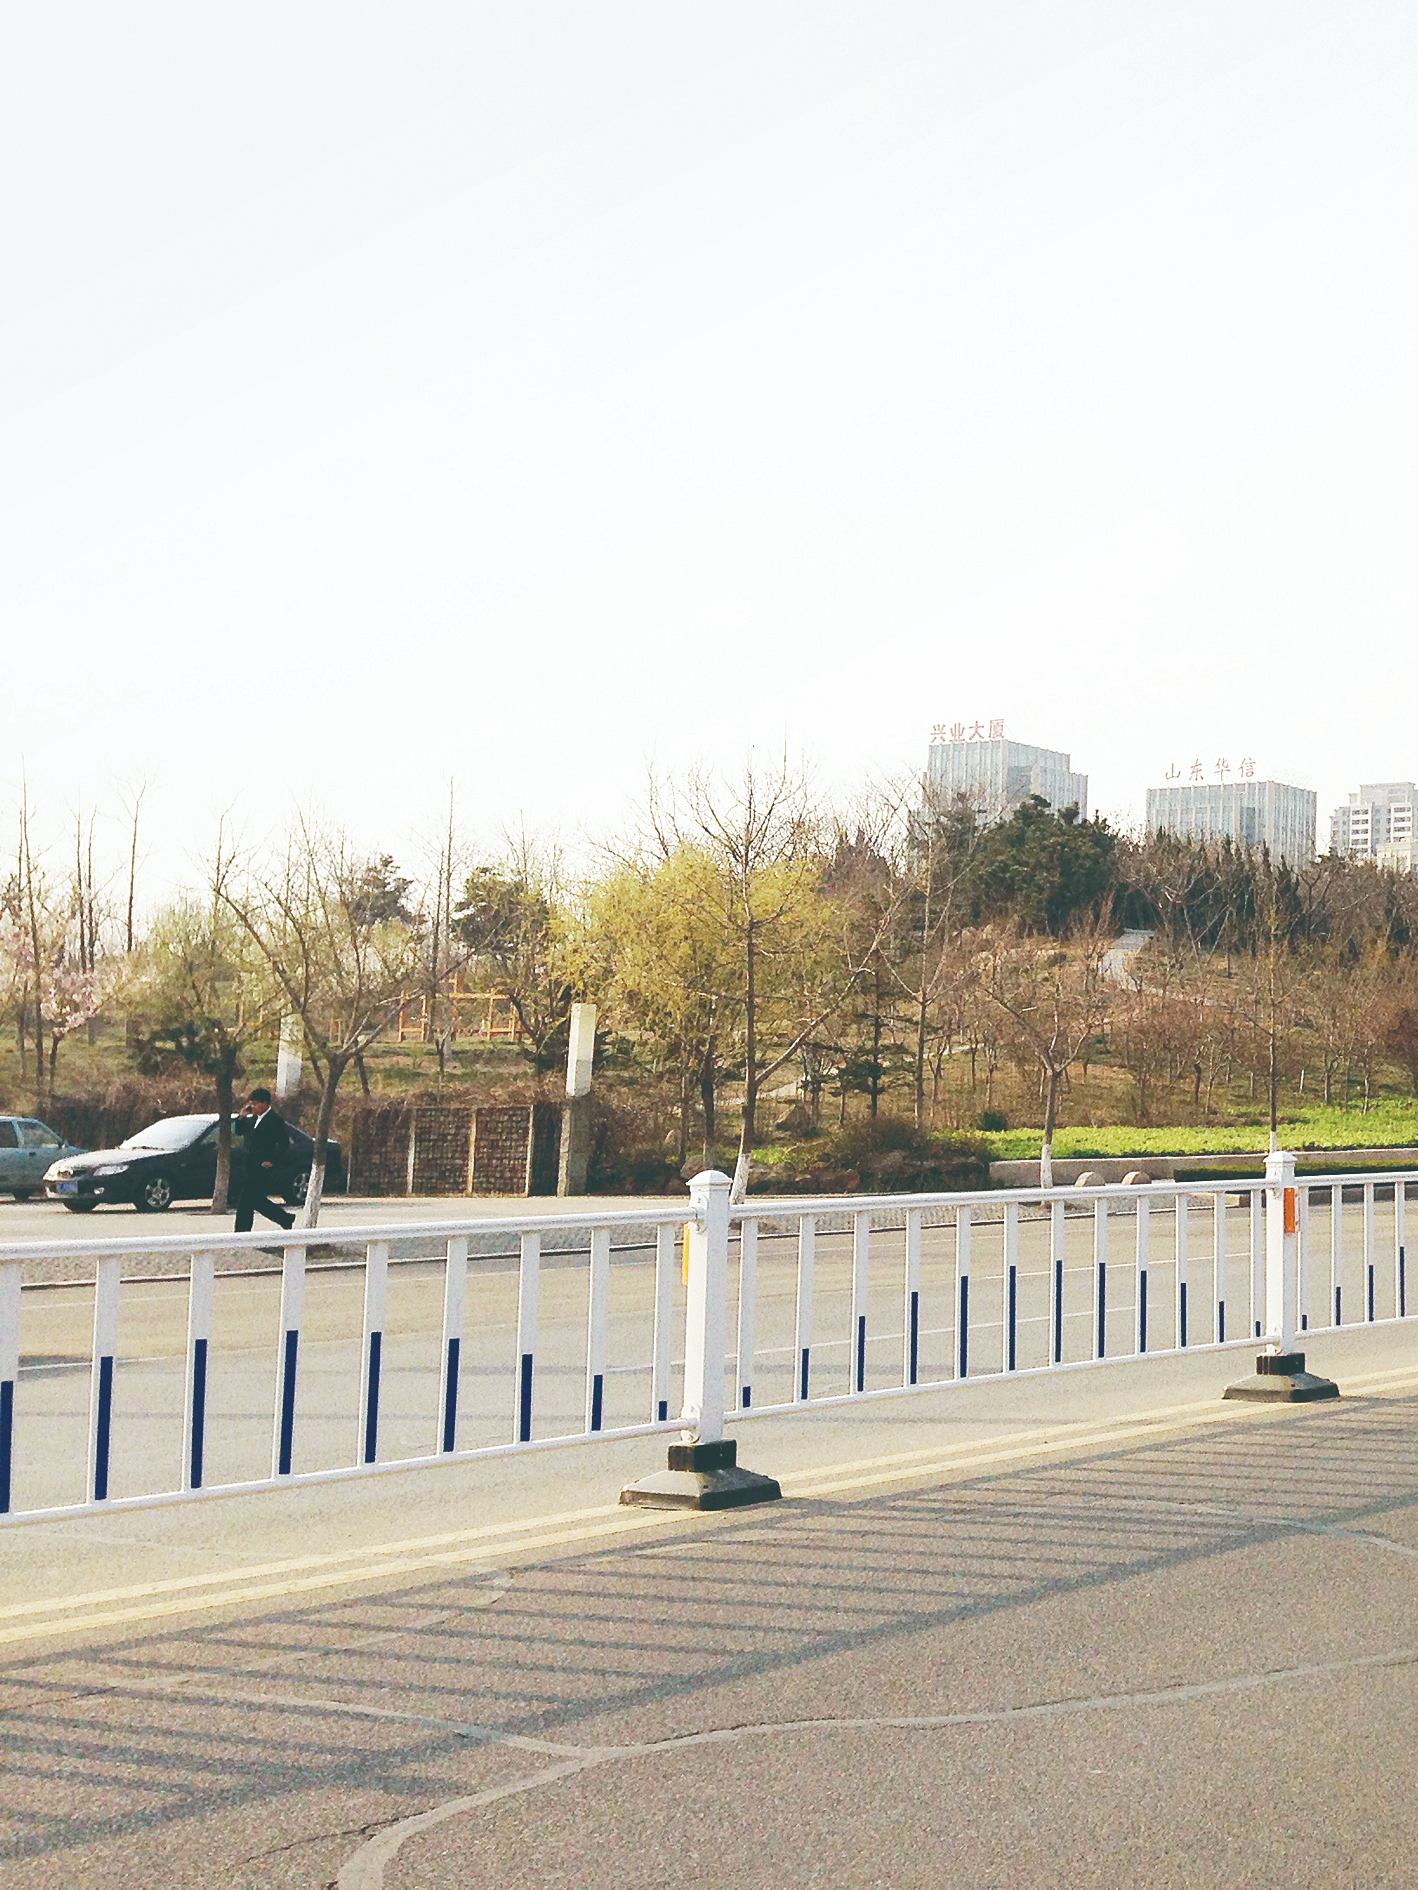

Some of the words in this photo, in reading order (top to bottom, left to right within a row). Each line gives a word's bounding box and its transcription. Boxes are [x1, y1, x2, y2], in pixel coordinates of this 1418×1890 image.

[930, 718, 1005, 743] 兴业大厦
[1165, 757, 1256, 781] 山东华信
